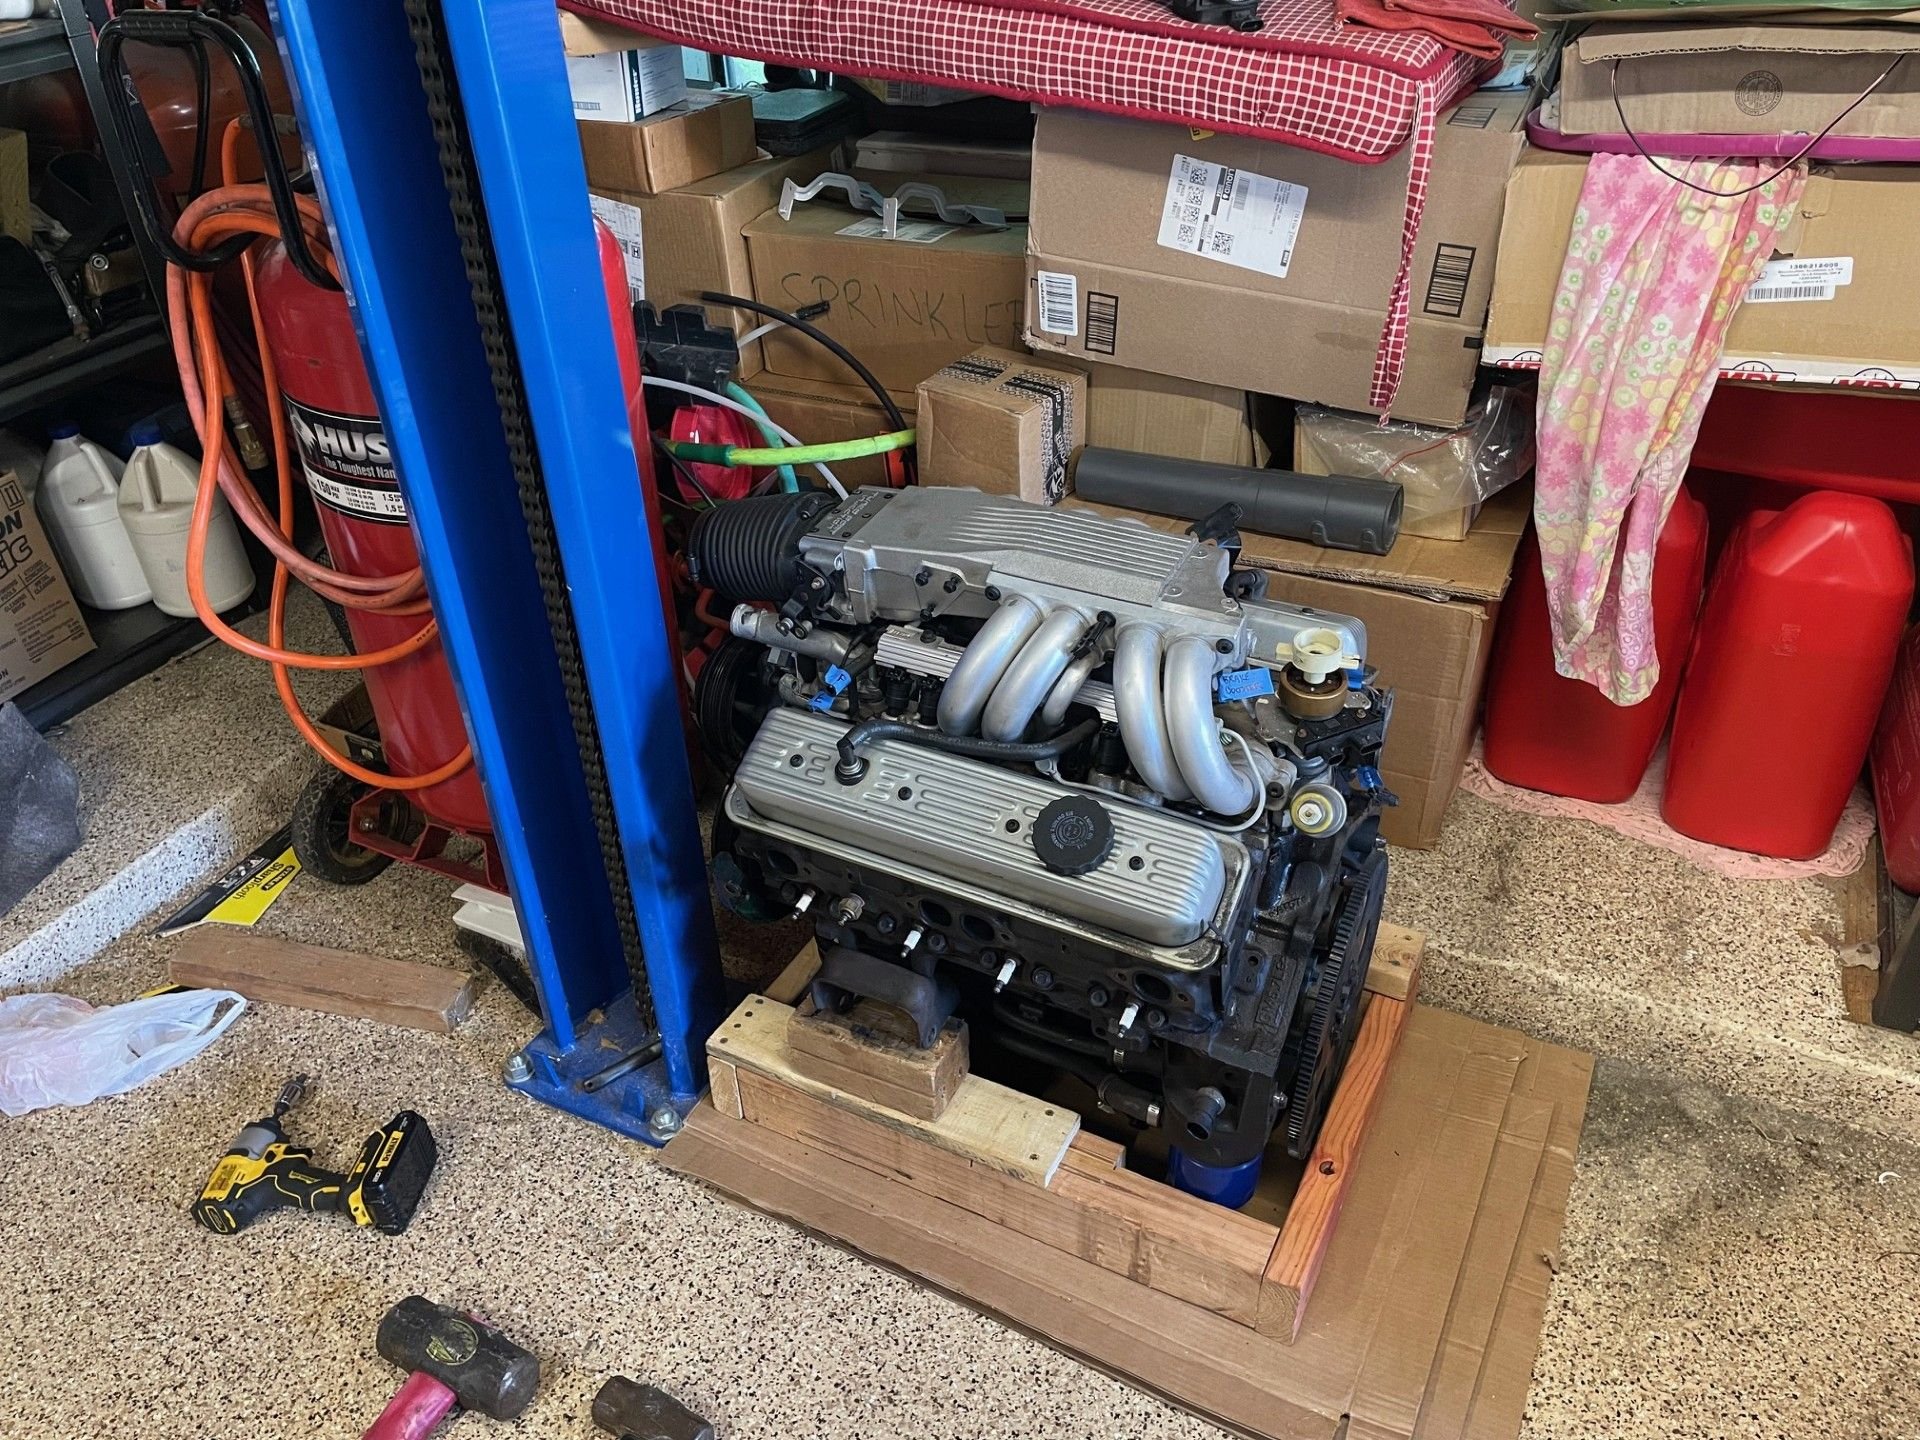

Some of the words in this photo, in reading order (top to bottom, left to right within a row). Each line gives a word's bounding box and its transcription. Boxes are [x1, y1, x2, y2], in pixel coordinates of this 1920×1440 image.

[1223, 168, 1236, 196] LIQUID
[323, 455, 338, 470] The
[337, 460, 377, 478] Toughest
[316, 479, 332, 496] 150
[231, 861, 285, 901] SharpTooth
[263, 866, 295, 891] STANLEY
